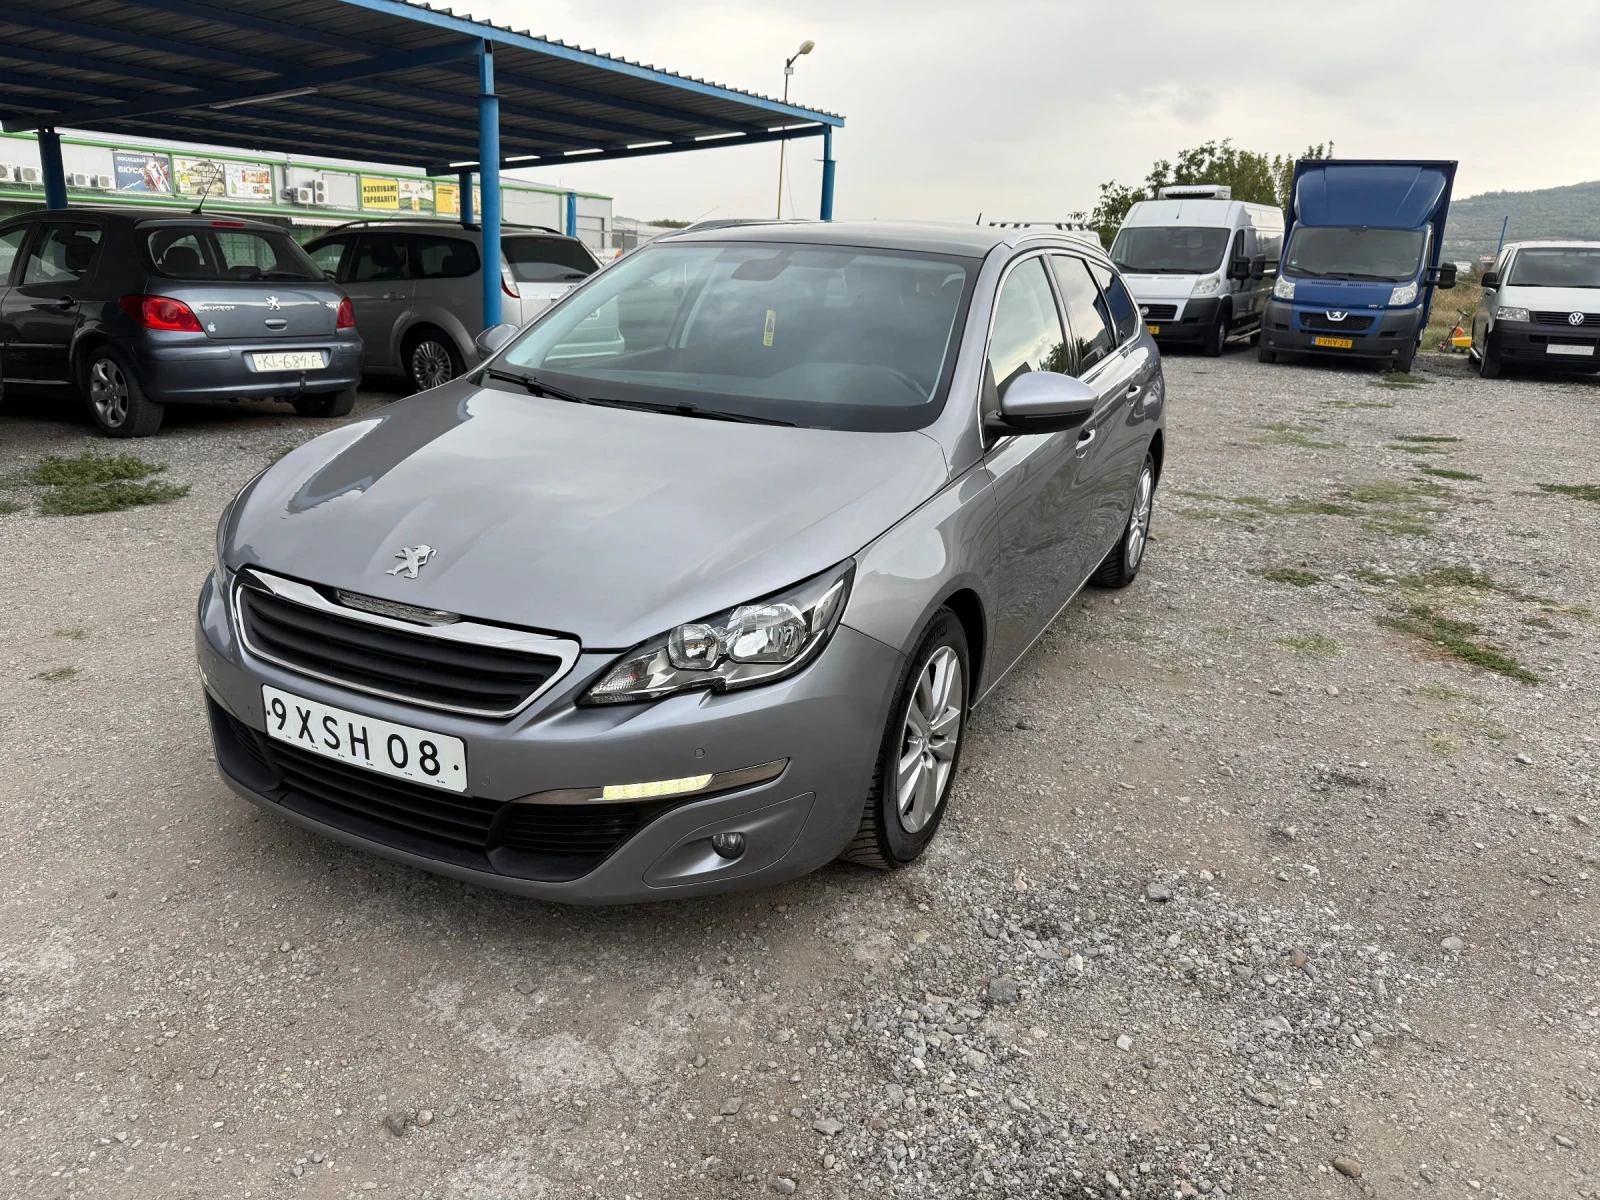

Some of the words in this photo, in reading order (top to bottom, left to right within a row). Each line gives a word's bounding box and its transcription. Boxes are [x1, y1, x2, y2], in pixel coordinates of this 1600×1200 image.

[118, 166, 143, 174] ВКУСА
[363, 185, 397, 193] ИЗКУПУВАМЕ
[363, 195, 397, 203] ЕВРОПАЛЕТИ
